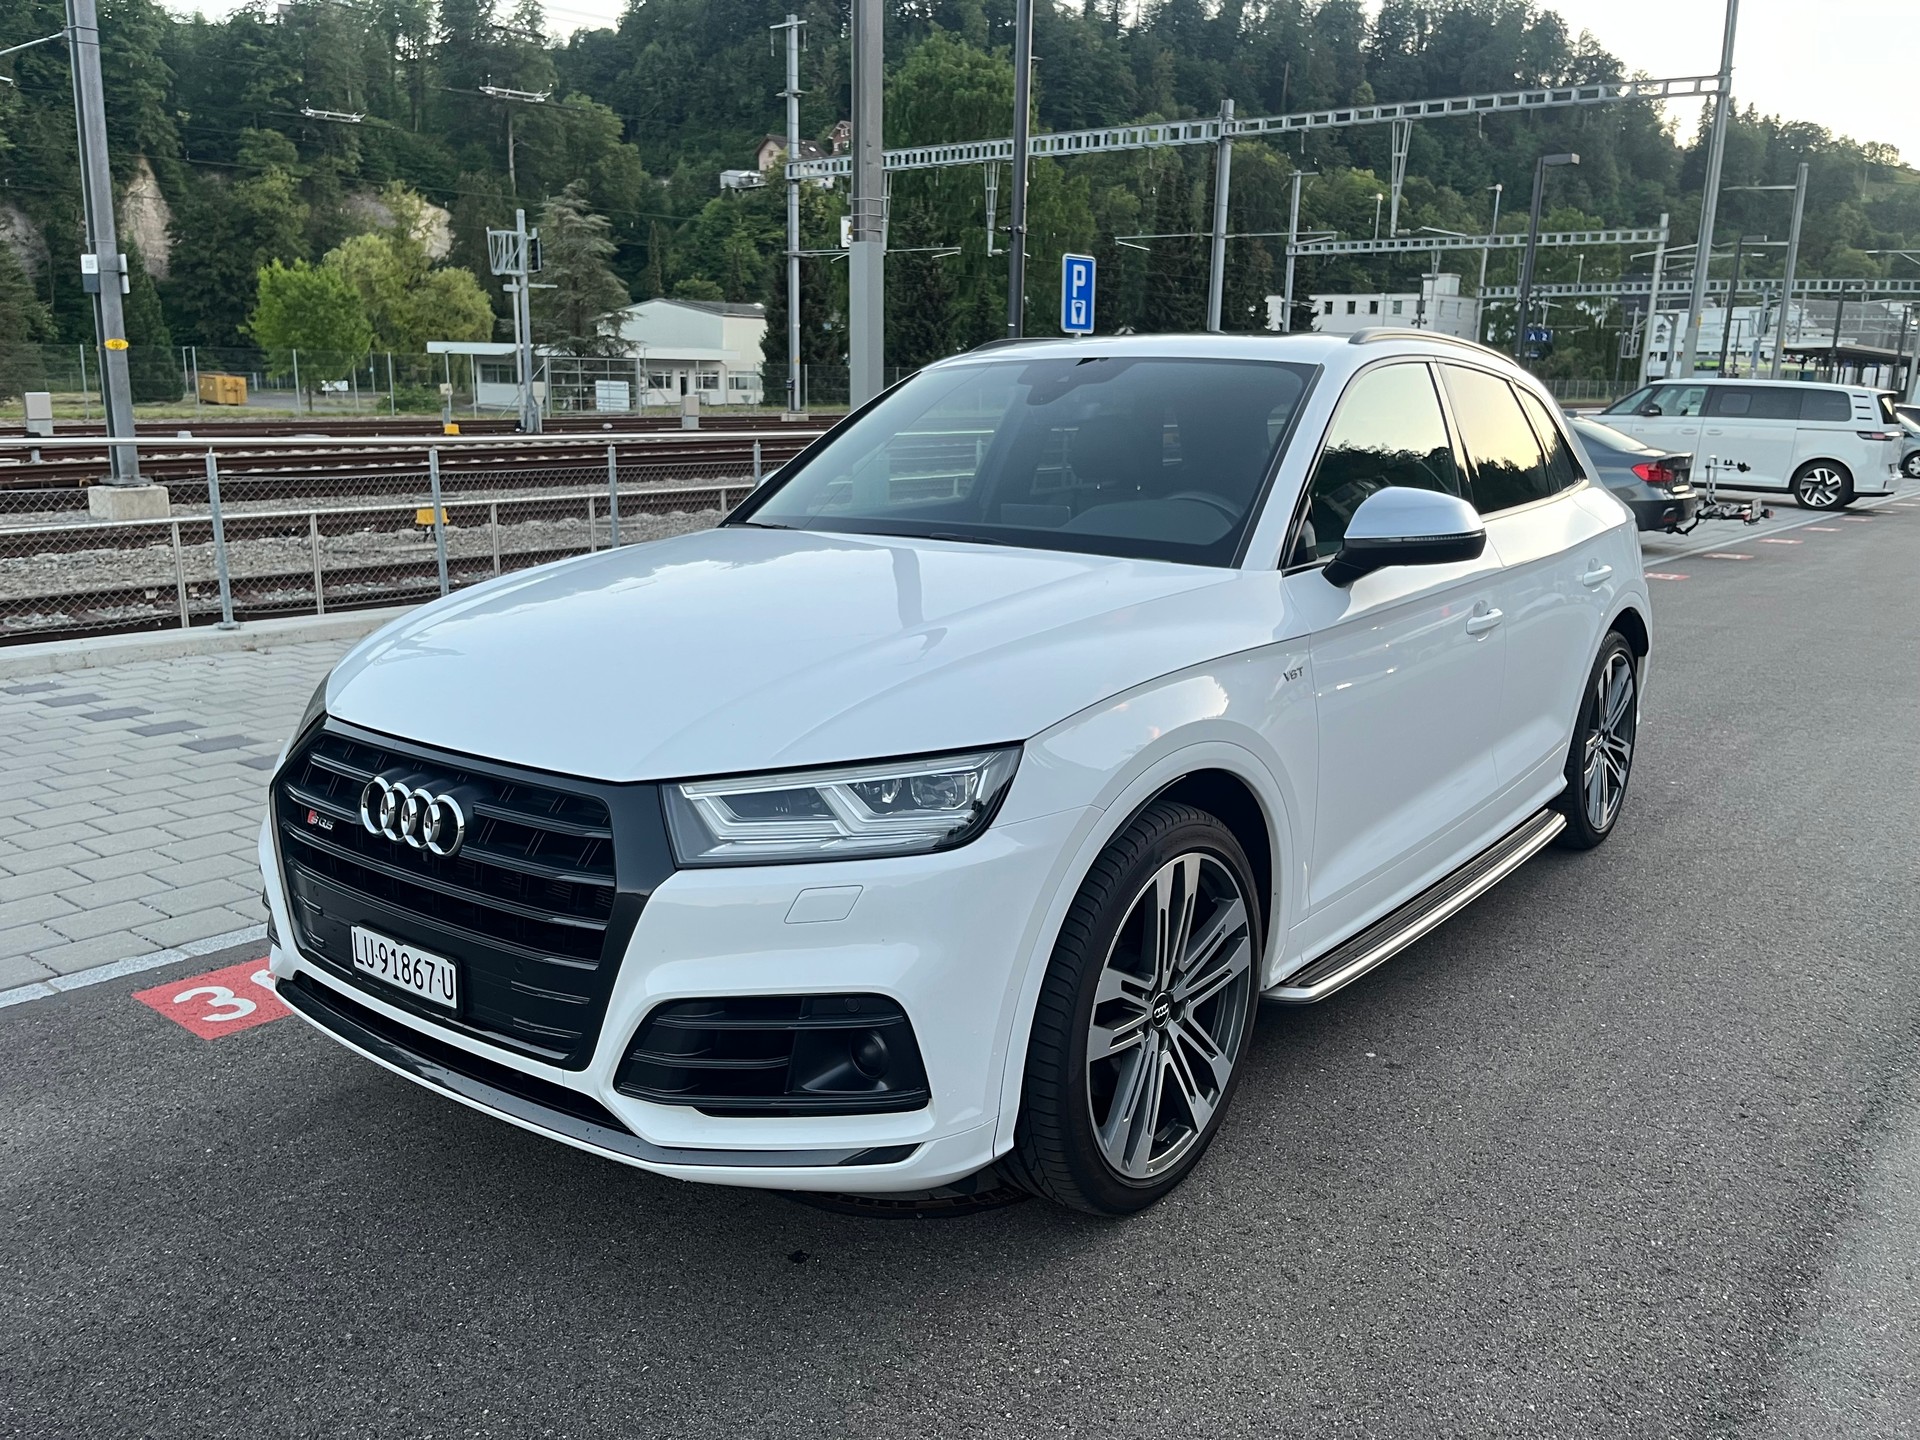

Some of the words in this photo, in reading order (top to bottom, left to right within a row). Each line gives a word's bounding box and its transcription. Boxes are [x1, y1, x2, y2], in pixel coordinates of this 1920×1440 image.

[1072, 264, 1086, 298] P
[1529, 333, 1536, 341] A
[1283, 666, 1303, 682] V6T
[173, 969, 276, 1022] 3
